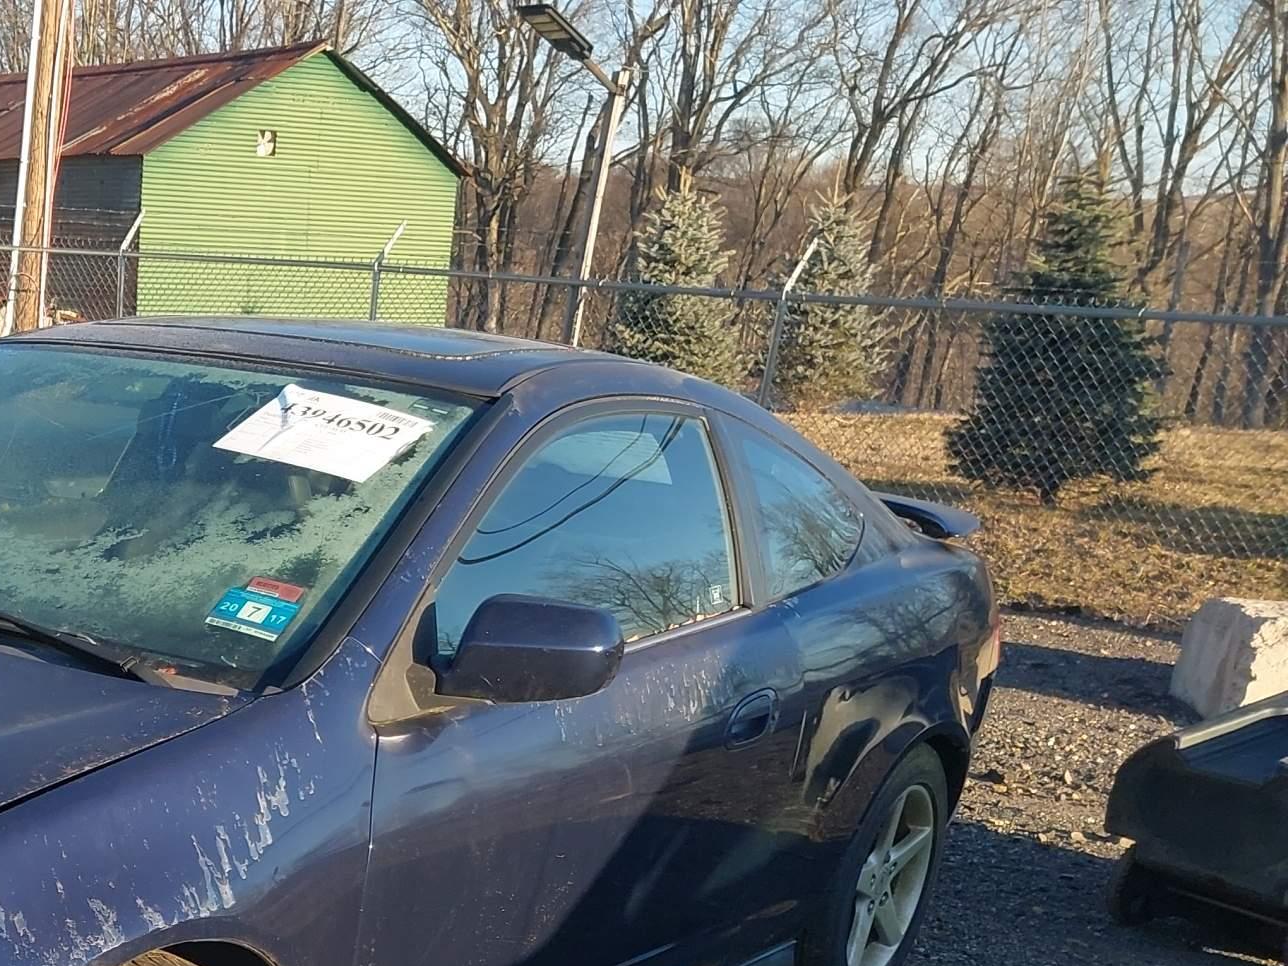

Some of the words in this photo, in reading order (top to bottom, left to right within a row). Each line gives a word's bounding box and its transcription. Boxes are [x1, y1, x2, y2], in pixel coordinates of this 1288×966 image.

[219, 601, 239, 612] 20
[247, 605, 263, 618] 7
[270, 614, 287, 625] 17
